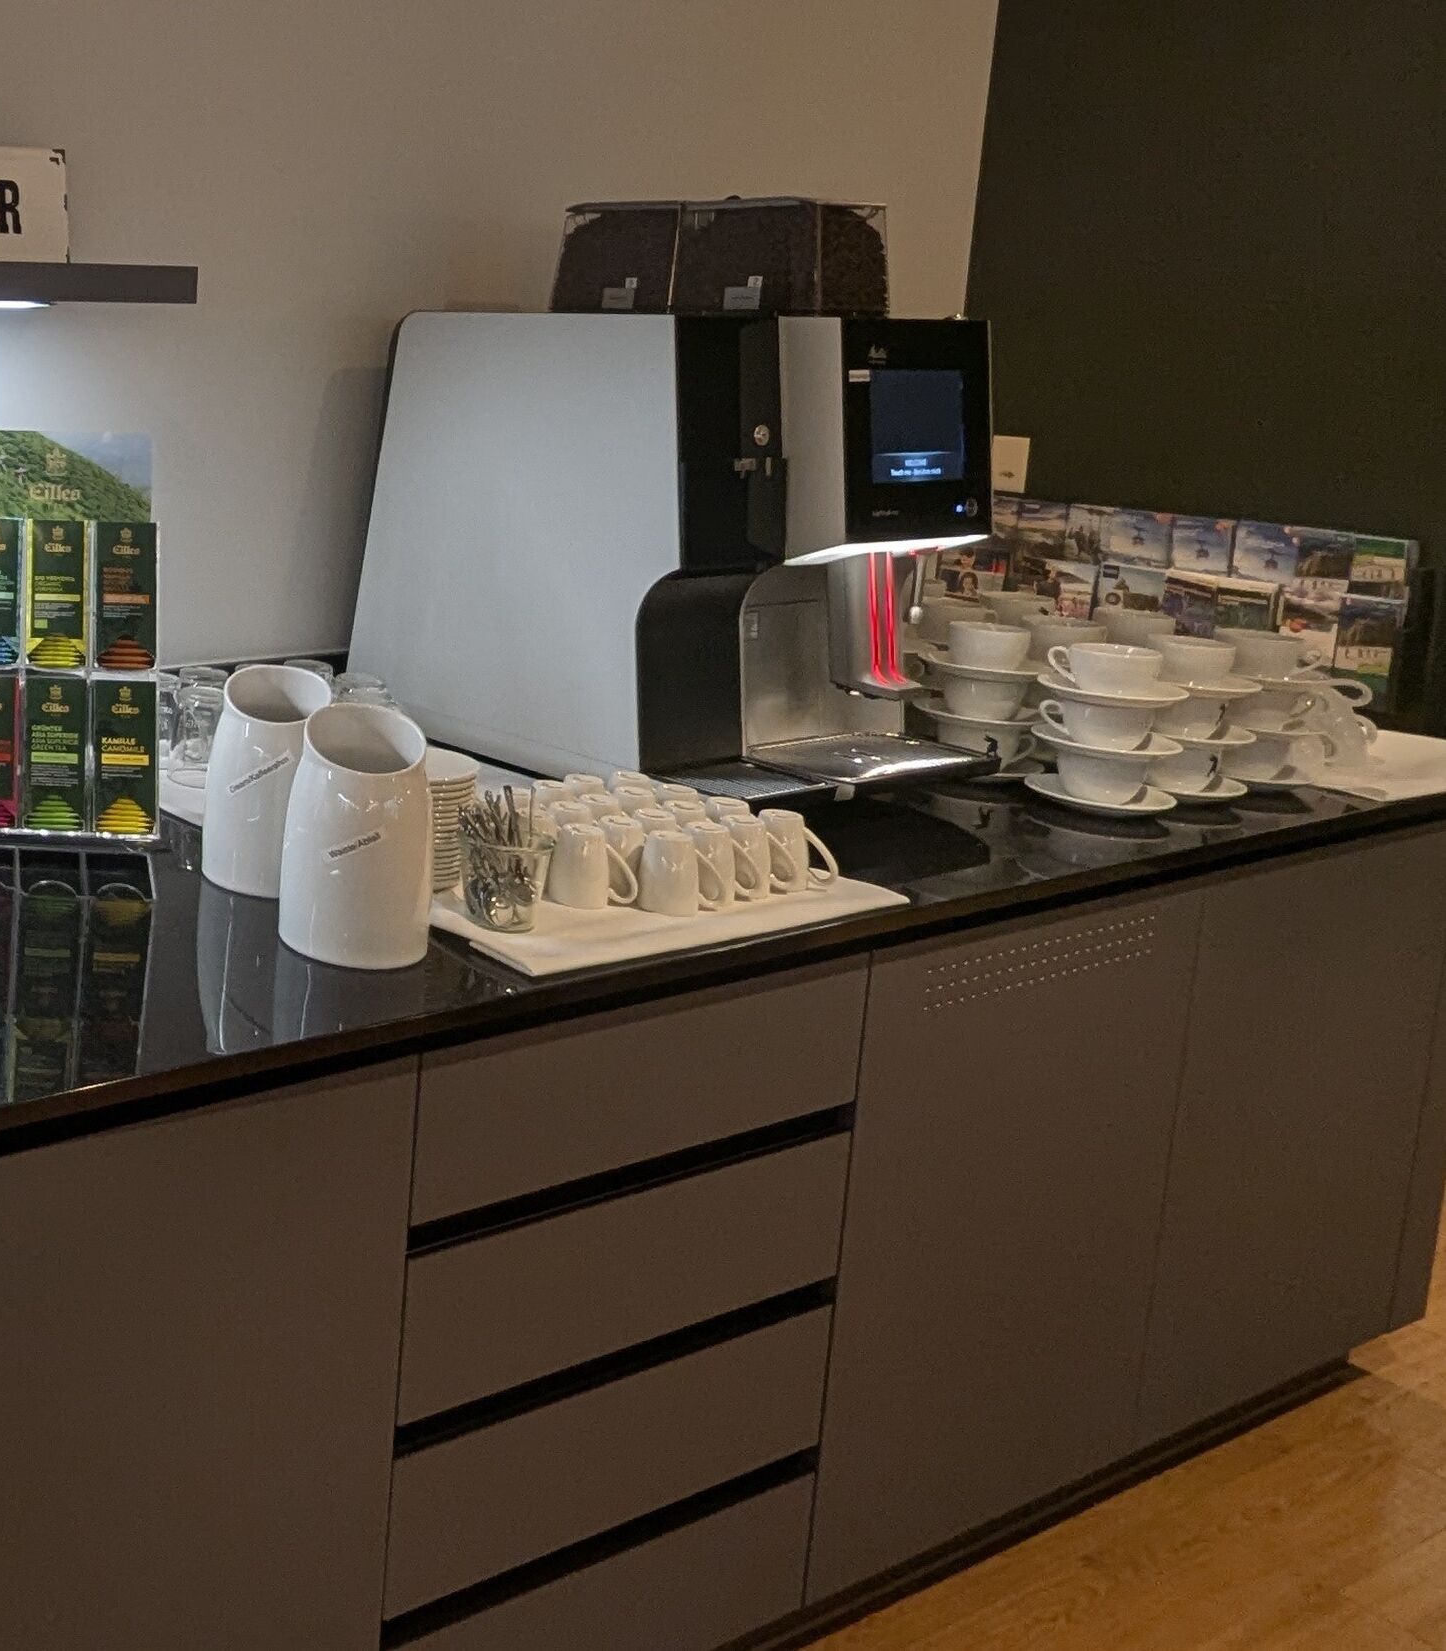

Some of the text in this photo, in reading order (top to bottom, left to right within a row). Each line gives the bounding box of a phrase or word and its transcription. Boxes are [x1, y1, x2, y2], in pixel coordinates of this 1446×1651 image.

[28, 484, 80, 501] Eilles
[41, 702, 70, 713] Eilles
[111, 703, 140, 715] Eilles
[102, 737, 136, 745] KAMILLE
